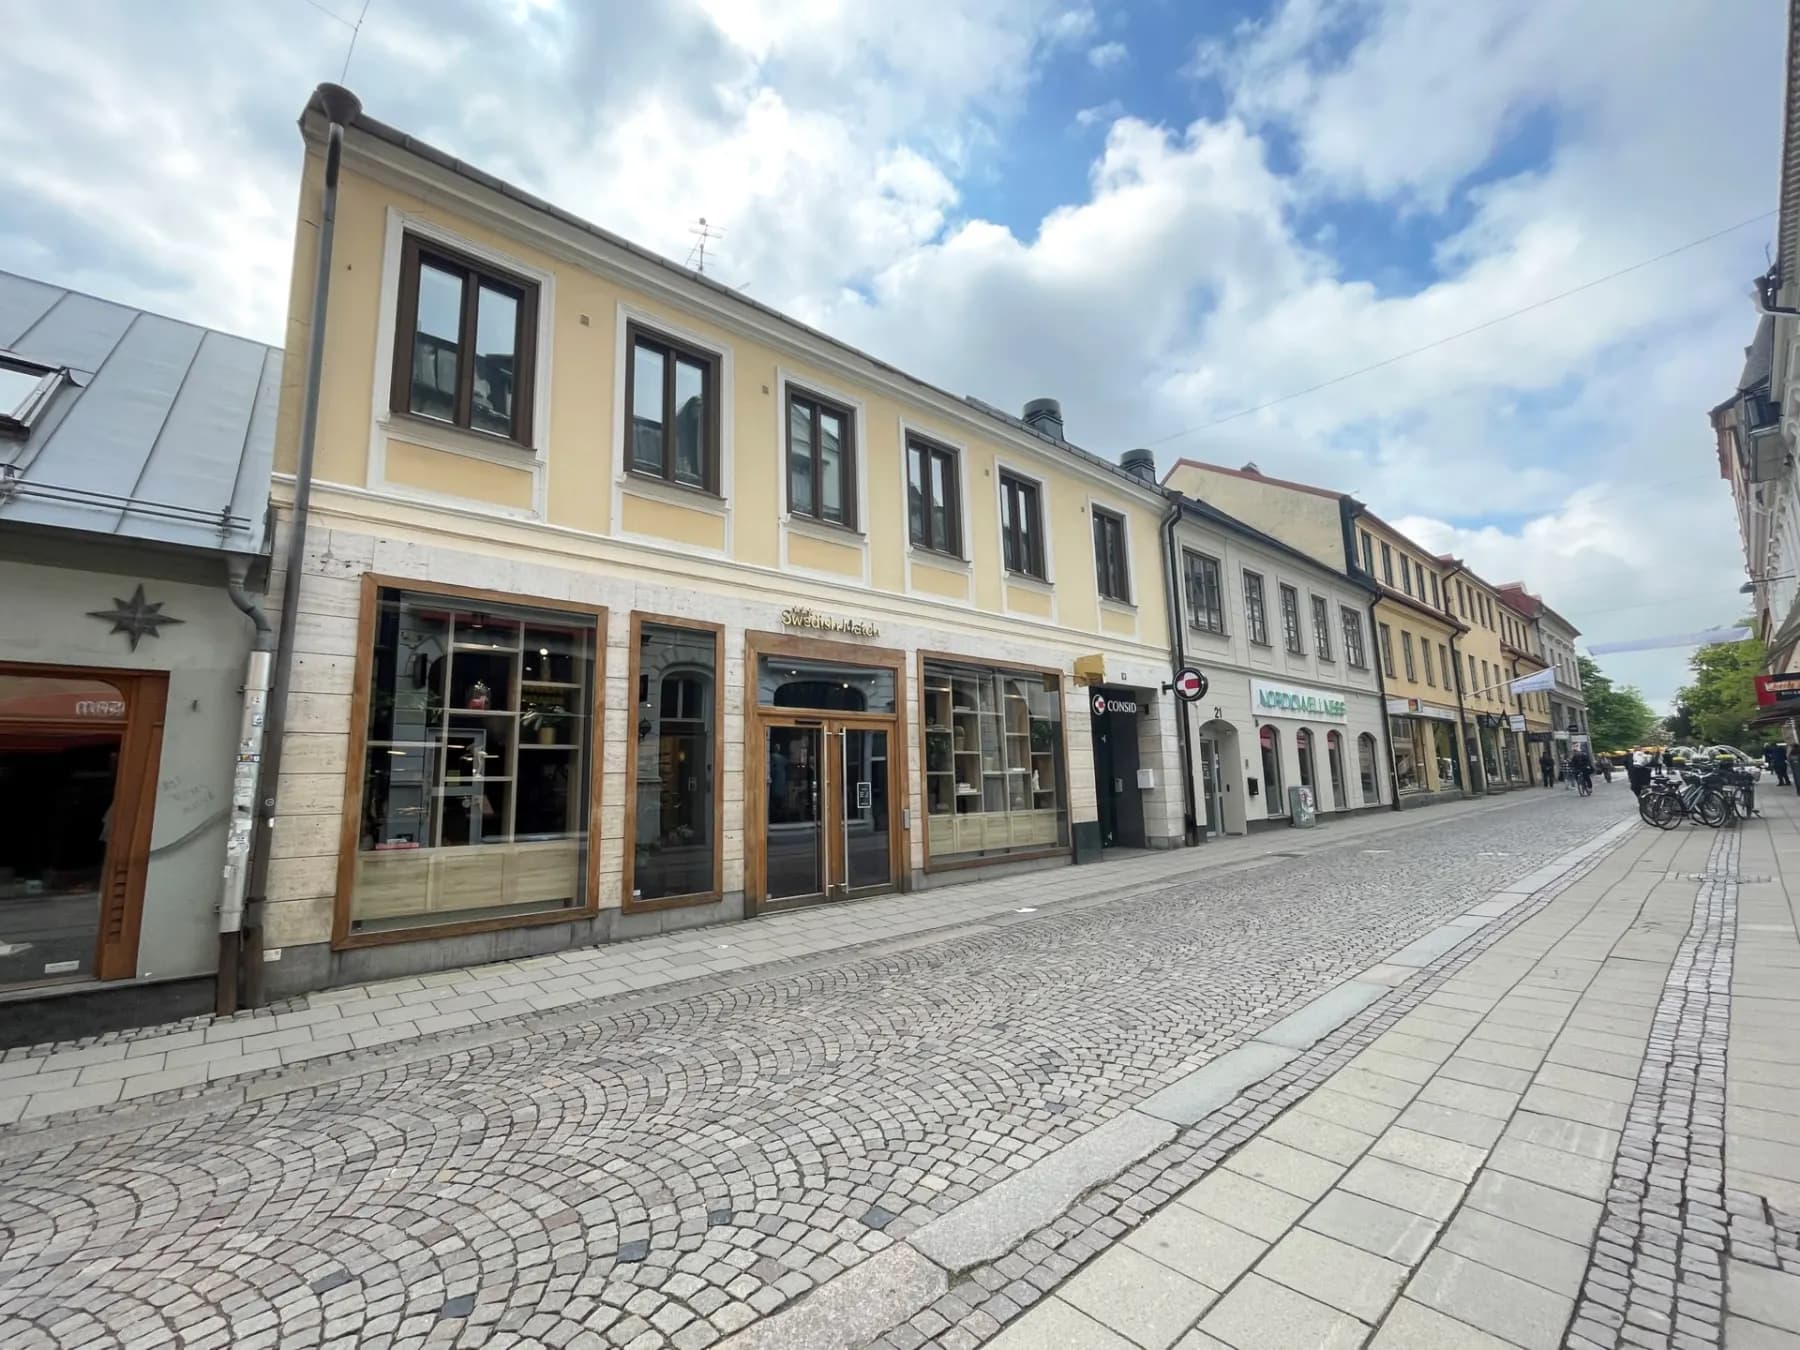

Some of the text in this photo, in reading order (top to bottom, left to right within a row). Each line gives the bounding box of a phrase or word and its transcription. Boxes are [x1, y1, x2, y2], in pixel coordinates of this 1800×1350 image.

[781, 608, 880, 637] Swedish Match
[1107, 700, 1137, 714] CONSID
[1214, 706, 1222, 719] 21
